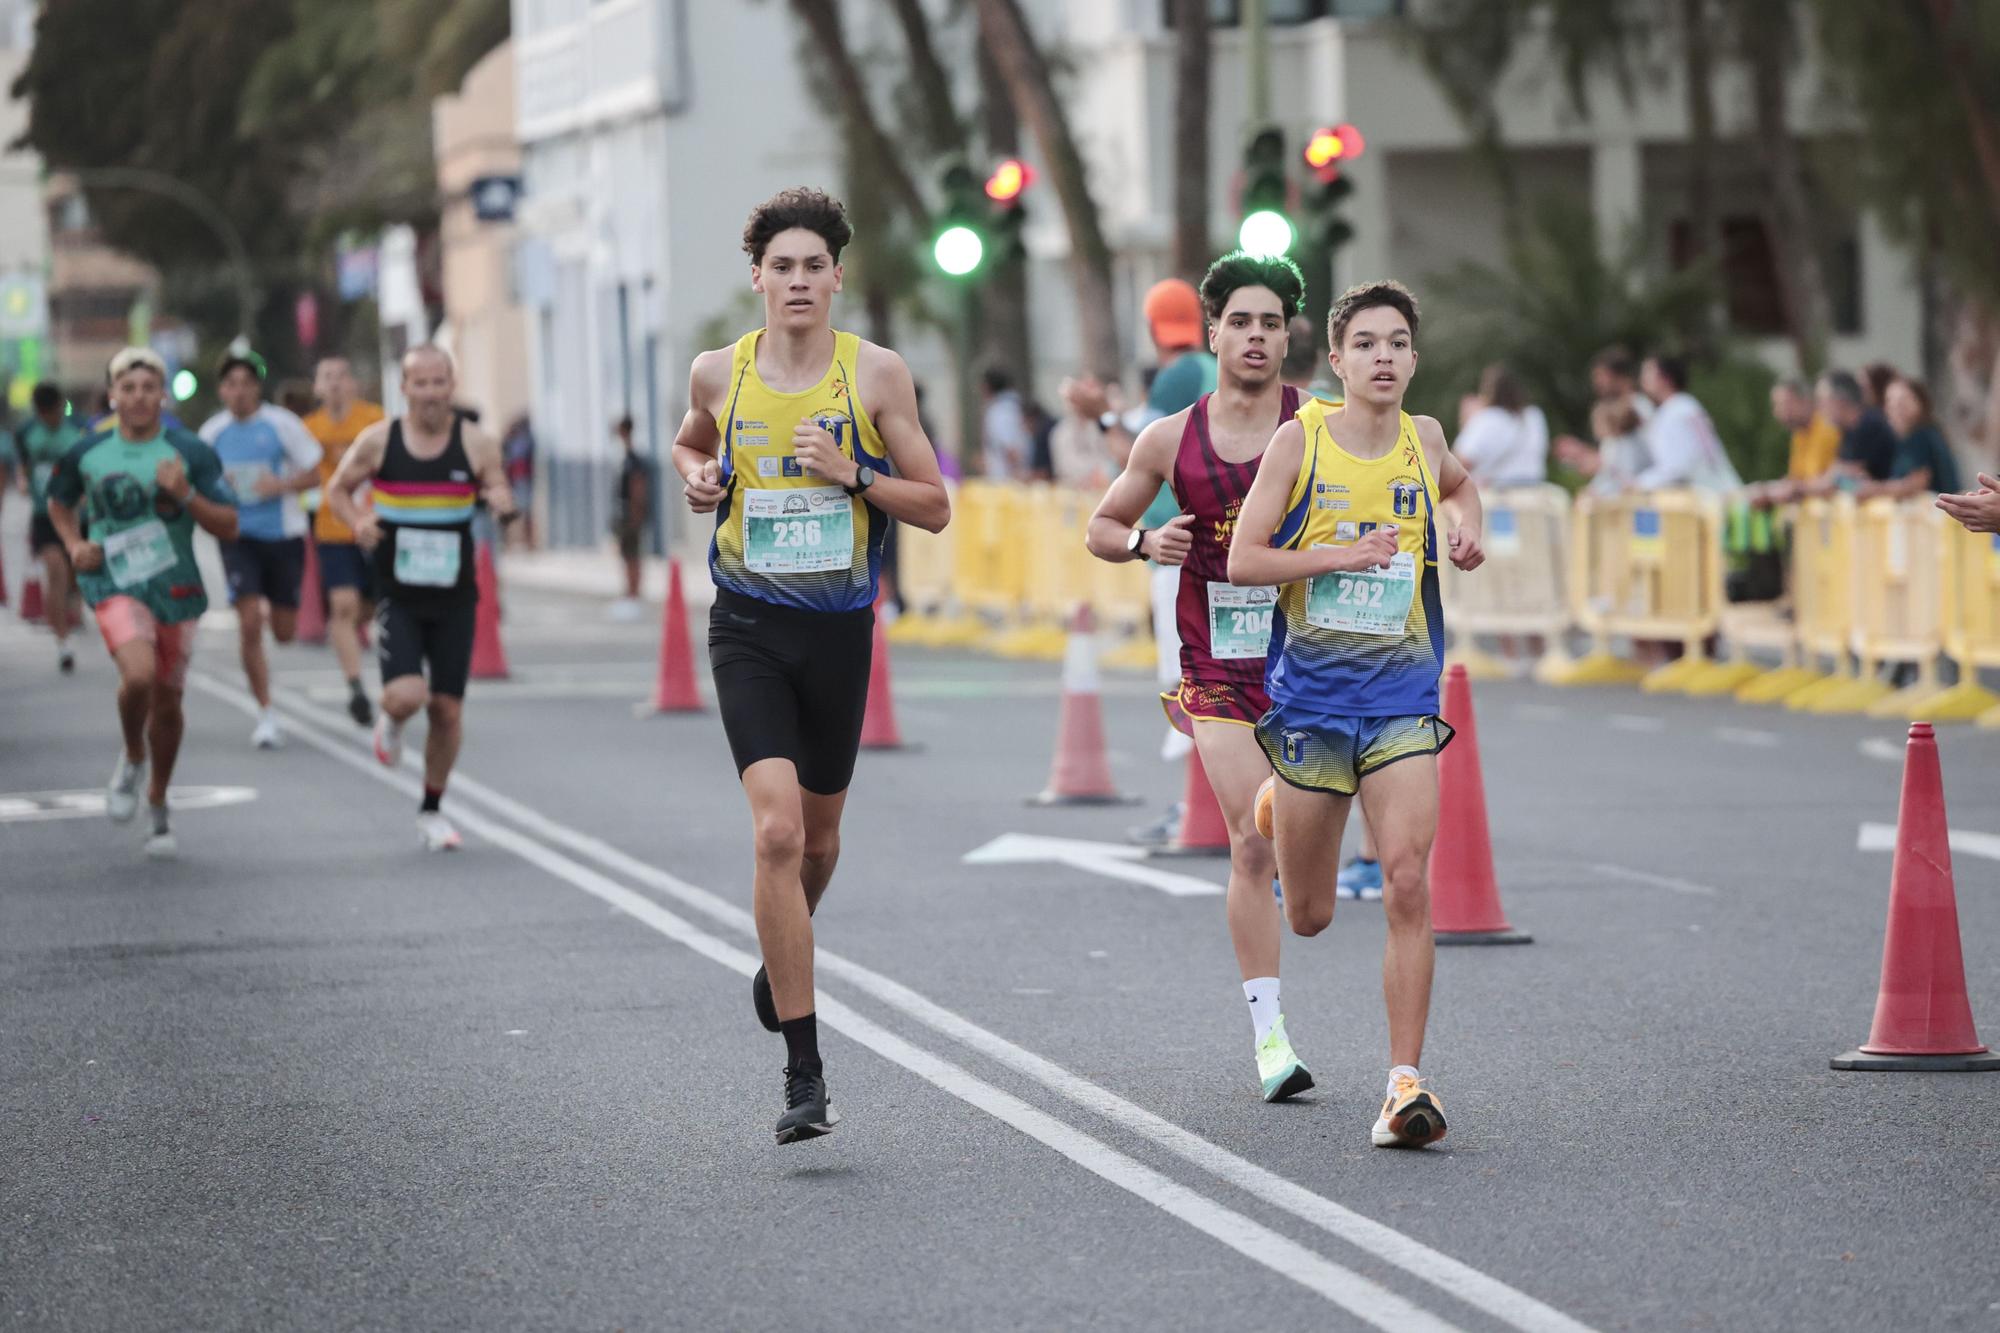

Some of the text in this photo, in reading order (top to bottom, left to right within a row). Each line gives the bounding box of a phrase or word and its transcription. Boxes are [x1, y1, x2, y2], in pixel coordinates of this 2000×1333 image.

[748, 504, 754, 512] 6
[772, 519, 821, 548] 236
[1337, 578, 1384, 608] 292
[1231, 610, 1272, 635] 204
